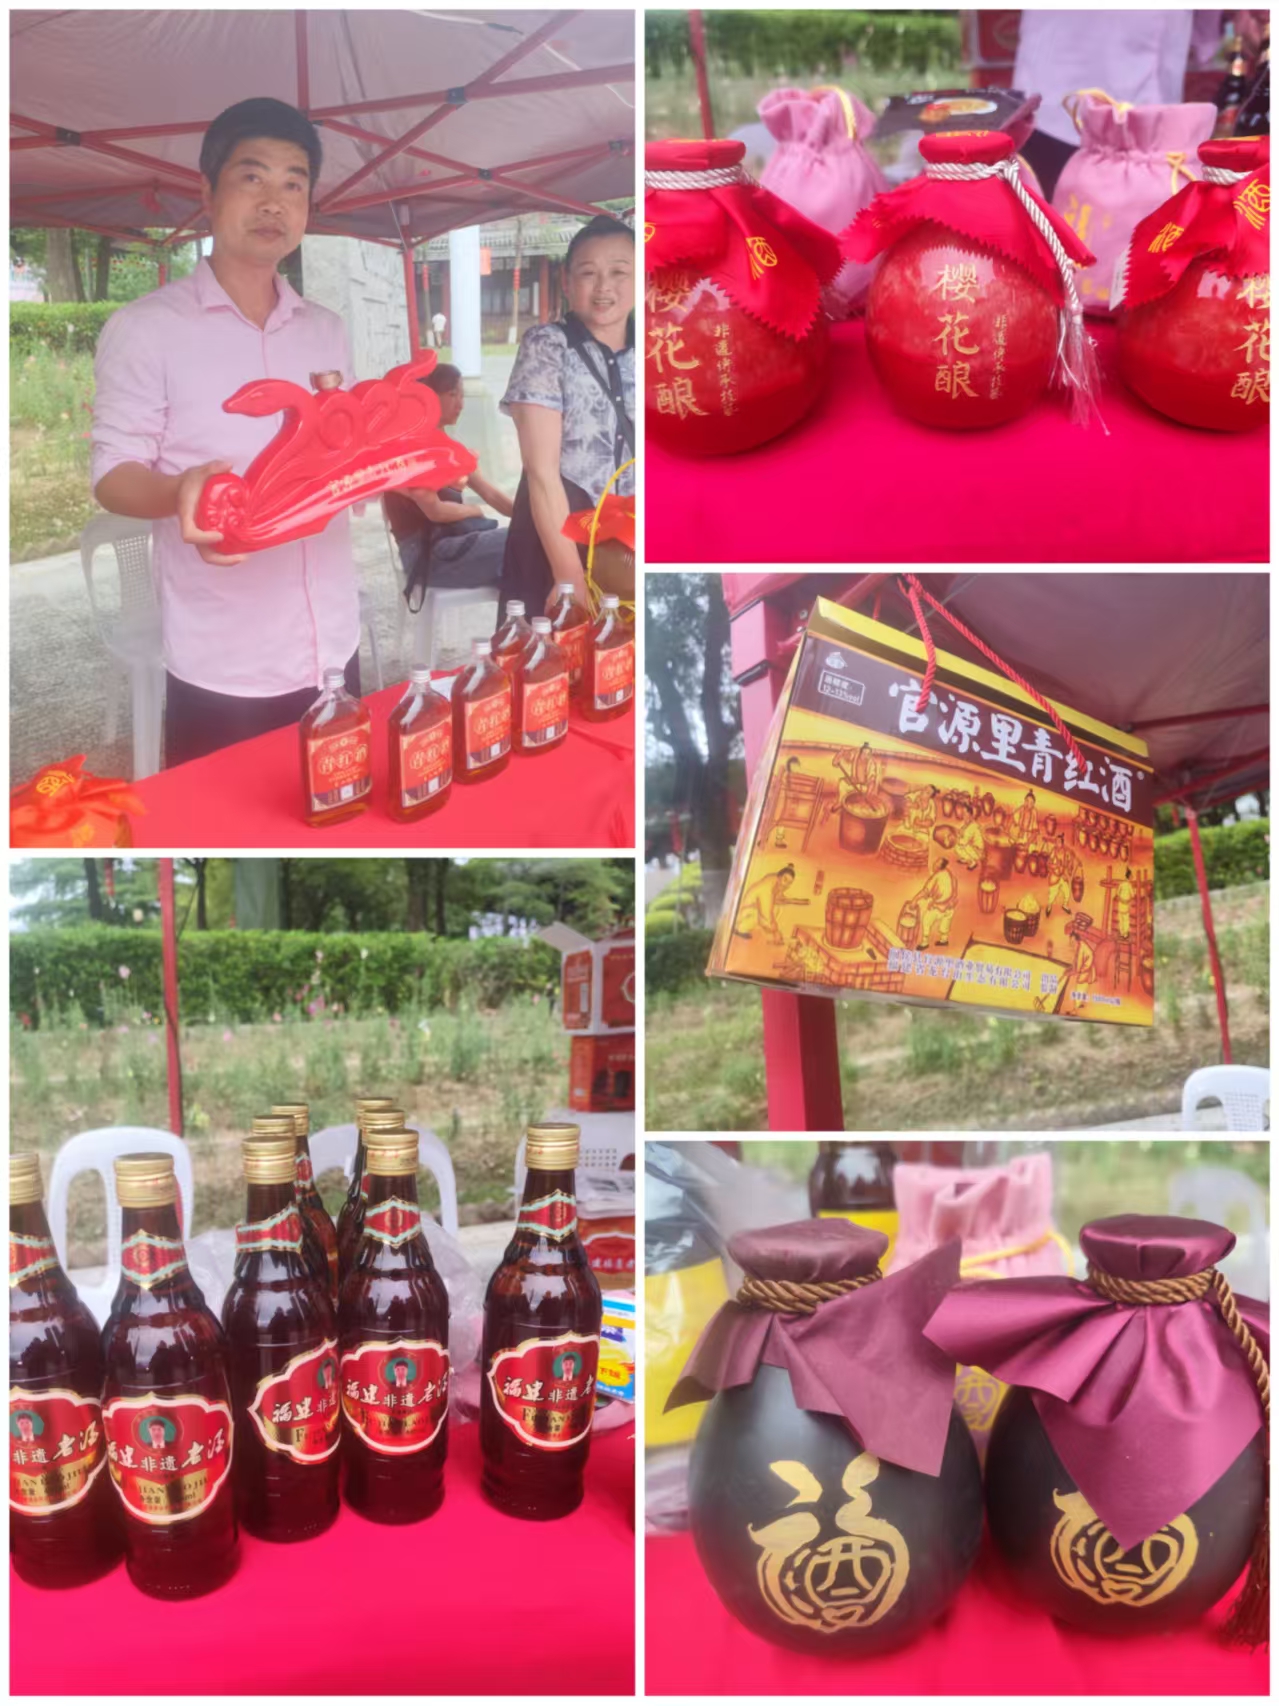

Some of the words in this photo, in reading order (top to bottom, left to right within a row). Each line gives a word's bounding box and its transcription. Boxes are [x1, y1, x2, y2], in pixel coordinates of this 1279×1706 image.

[929, 263, 980, 399] 樱花酿
[888, 678, 1134, 813] 官源里青红酒
